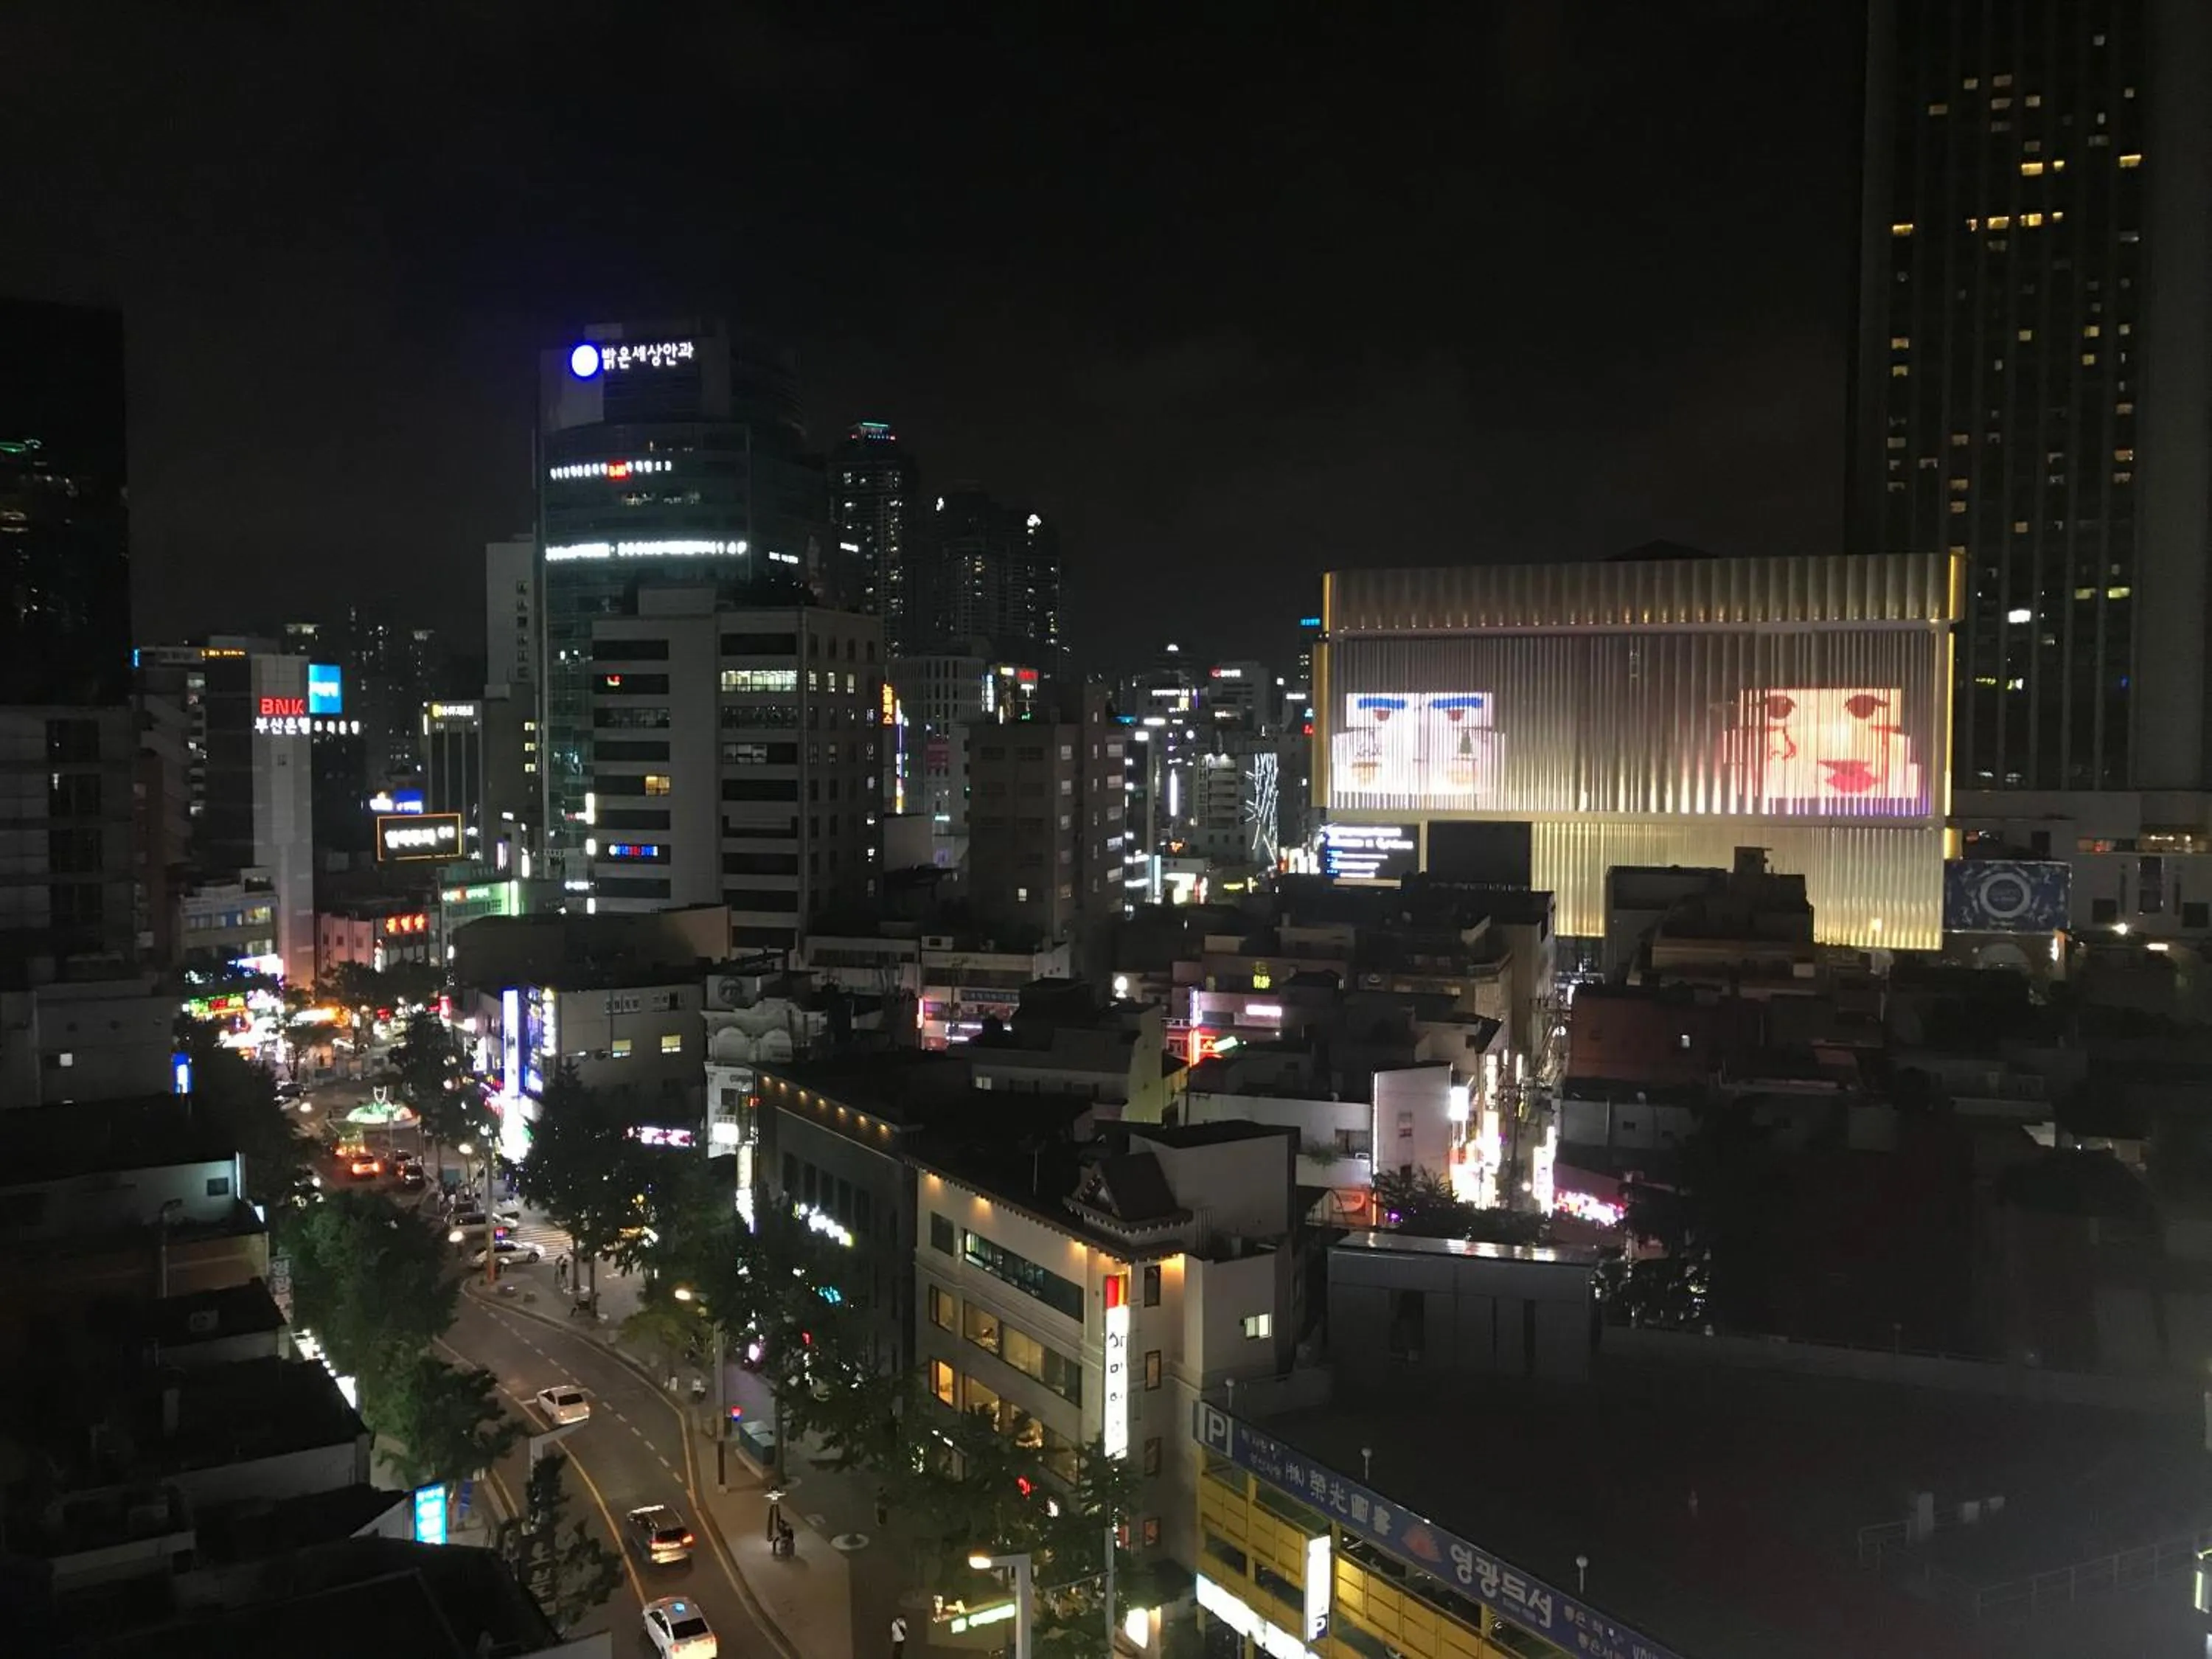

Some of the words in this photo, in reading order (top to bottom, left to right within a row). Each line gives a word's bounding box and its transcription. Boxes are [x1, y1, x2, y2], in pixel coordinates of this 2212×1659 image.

[601, 341, 694, 370] 밝은세상안과
[260, 698, 305, 715] BNK
[255, 717, 310, 735] 부산은행
[1208, 1410, 1226, 1444] P
[1449, 1543, 1553, 1630] 영광도서
